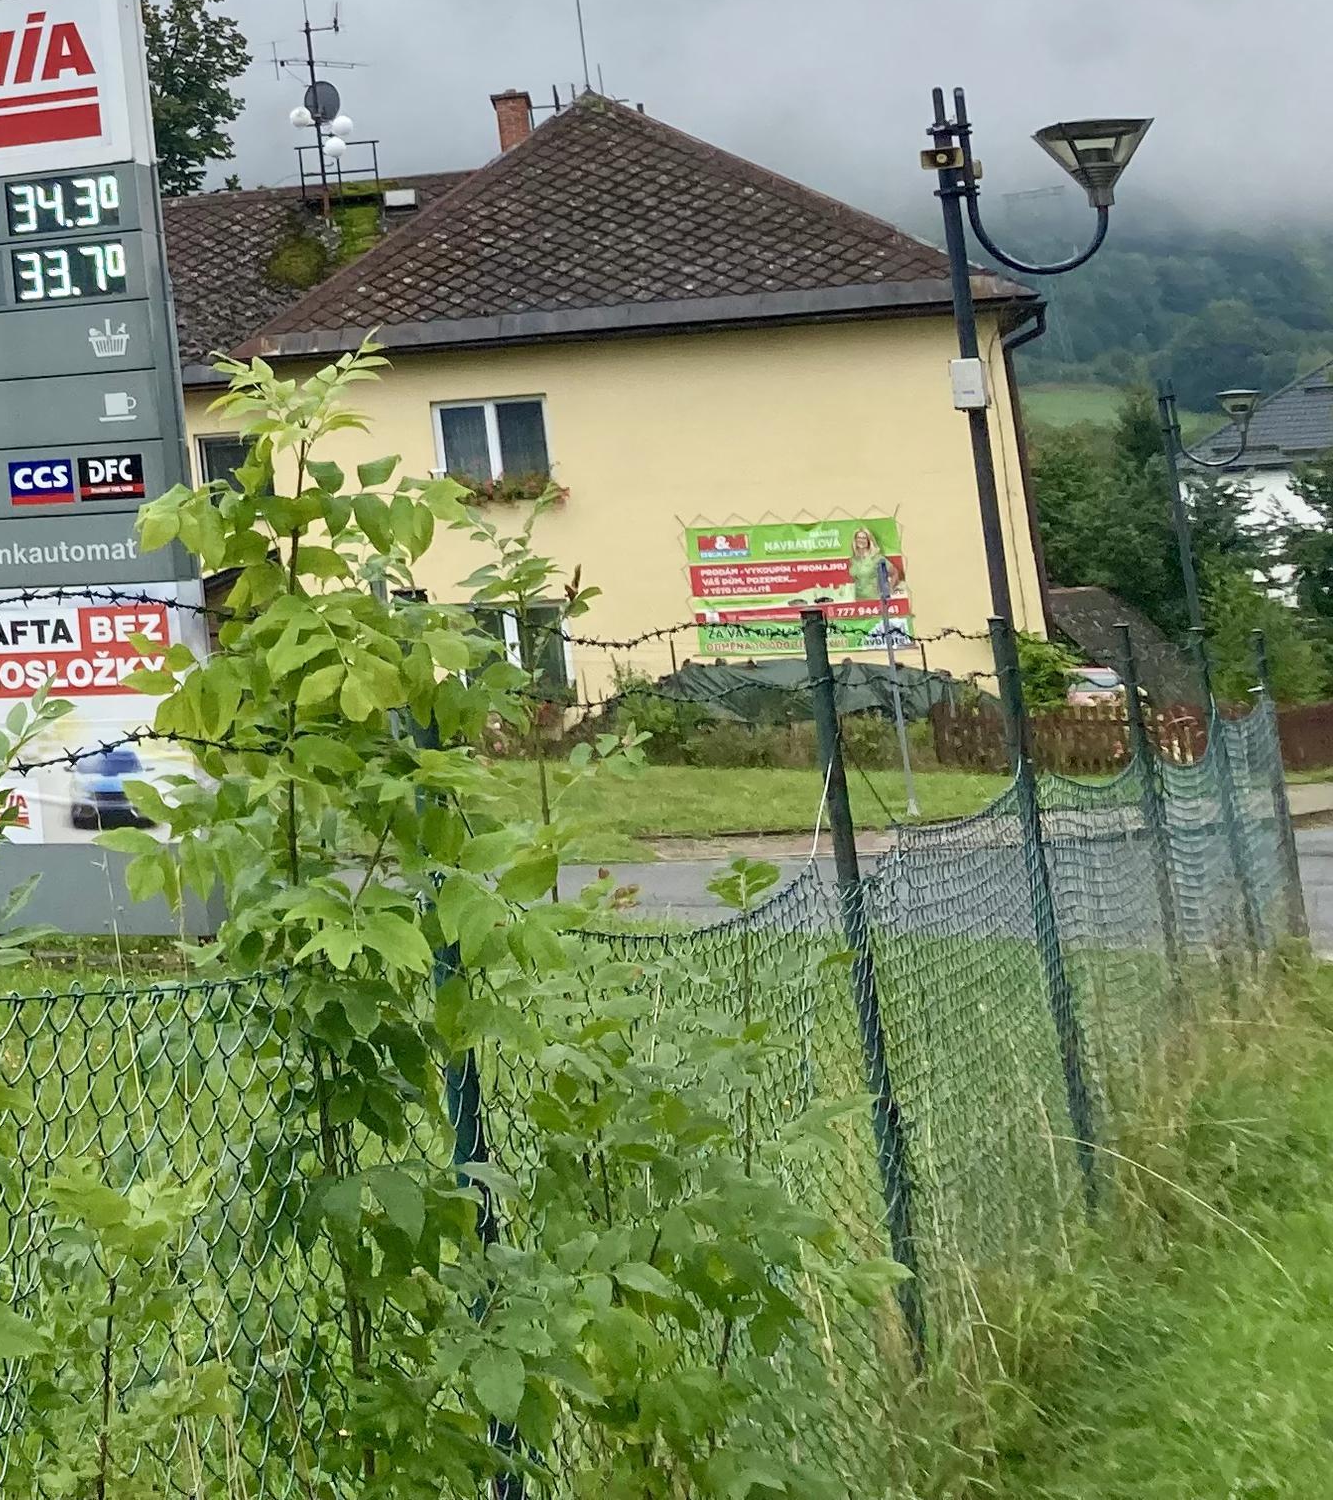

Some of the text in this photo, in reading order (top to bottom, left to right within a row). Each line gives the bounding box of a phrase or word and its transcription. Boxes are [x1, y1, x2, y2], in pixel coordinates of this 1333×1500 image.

[10, 175, 120, 233] 34.30
[16, 244, 126, 300] 33.70
[13, 464, 69, 490] CCS
[88, 457, 133, 484] DFC
[89, 613, 164, 644] BEZ
